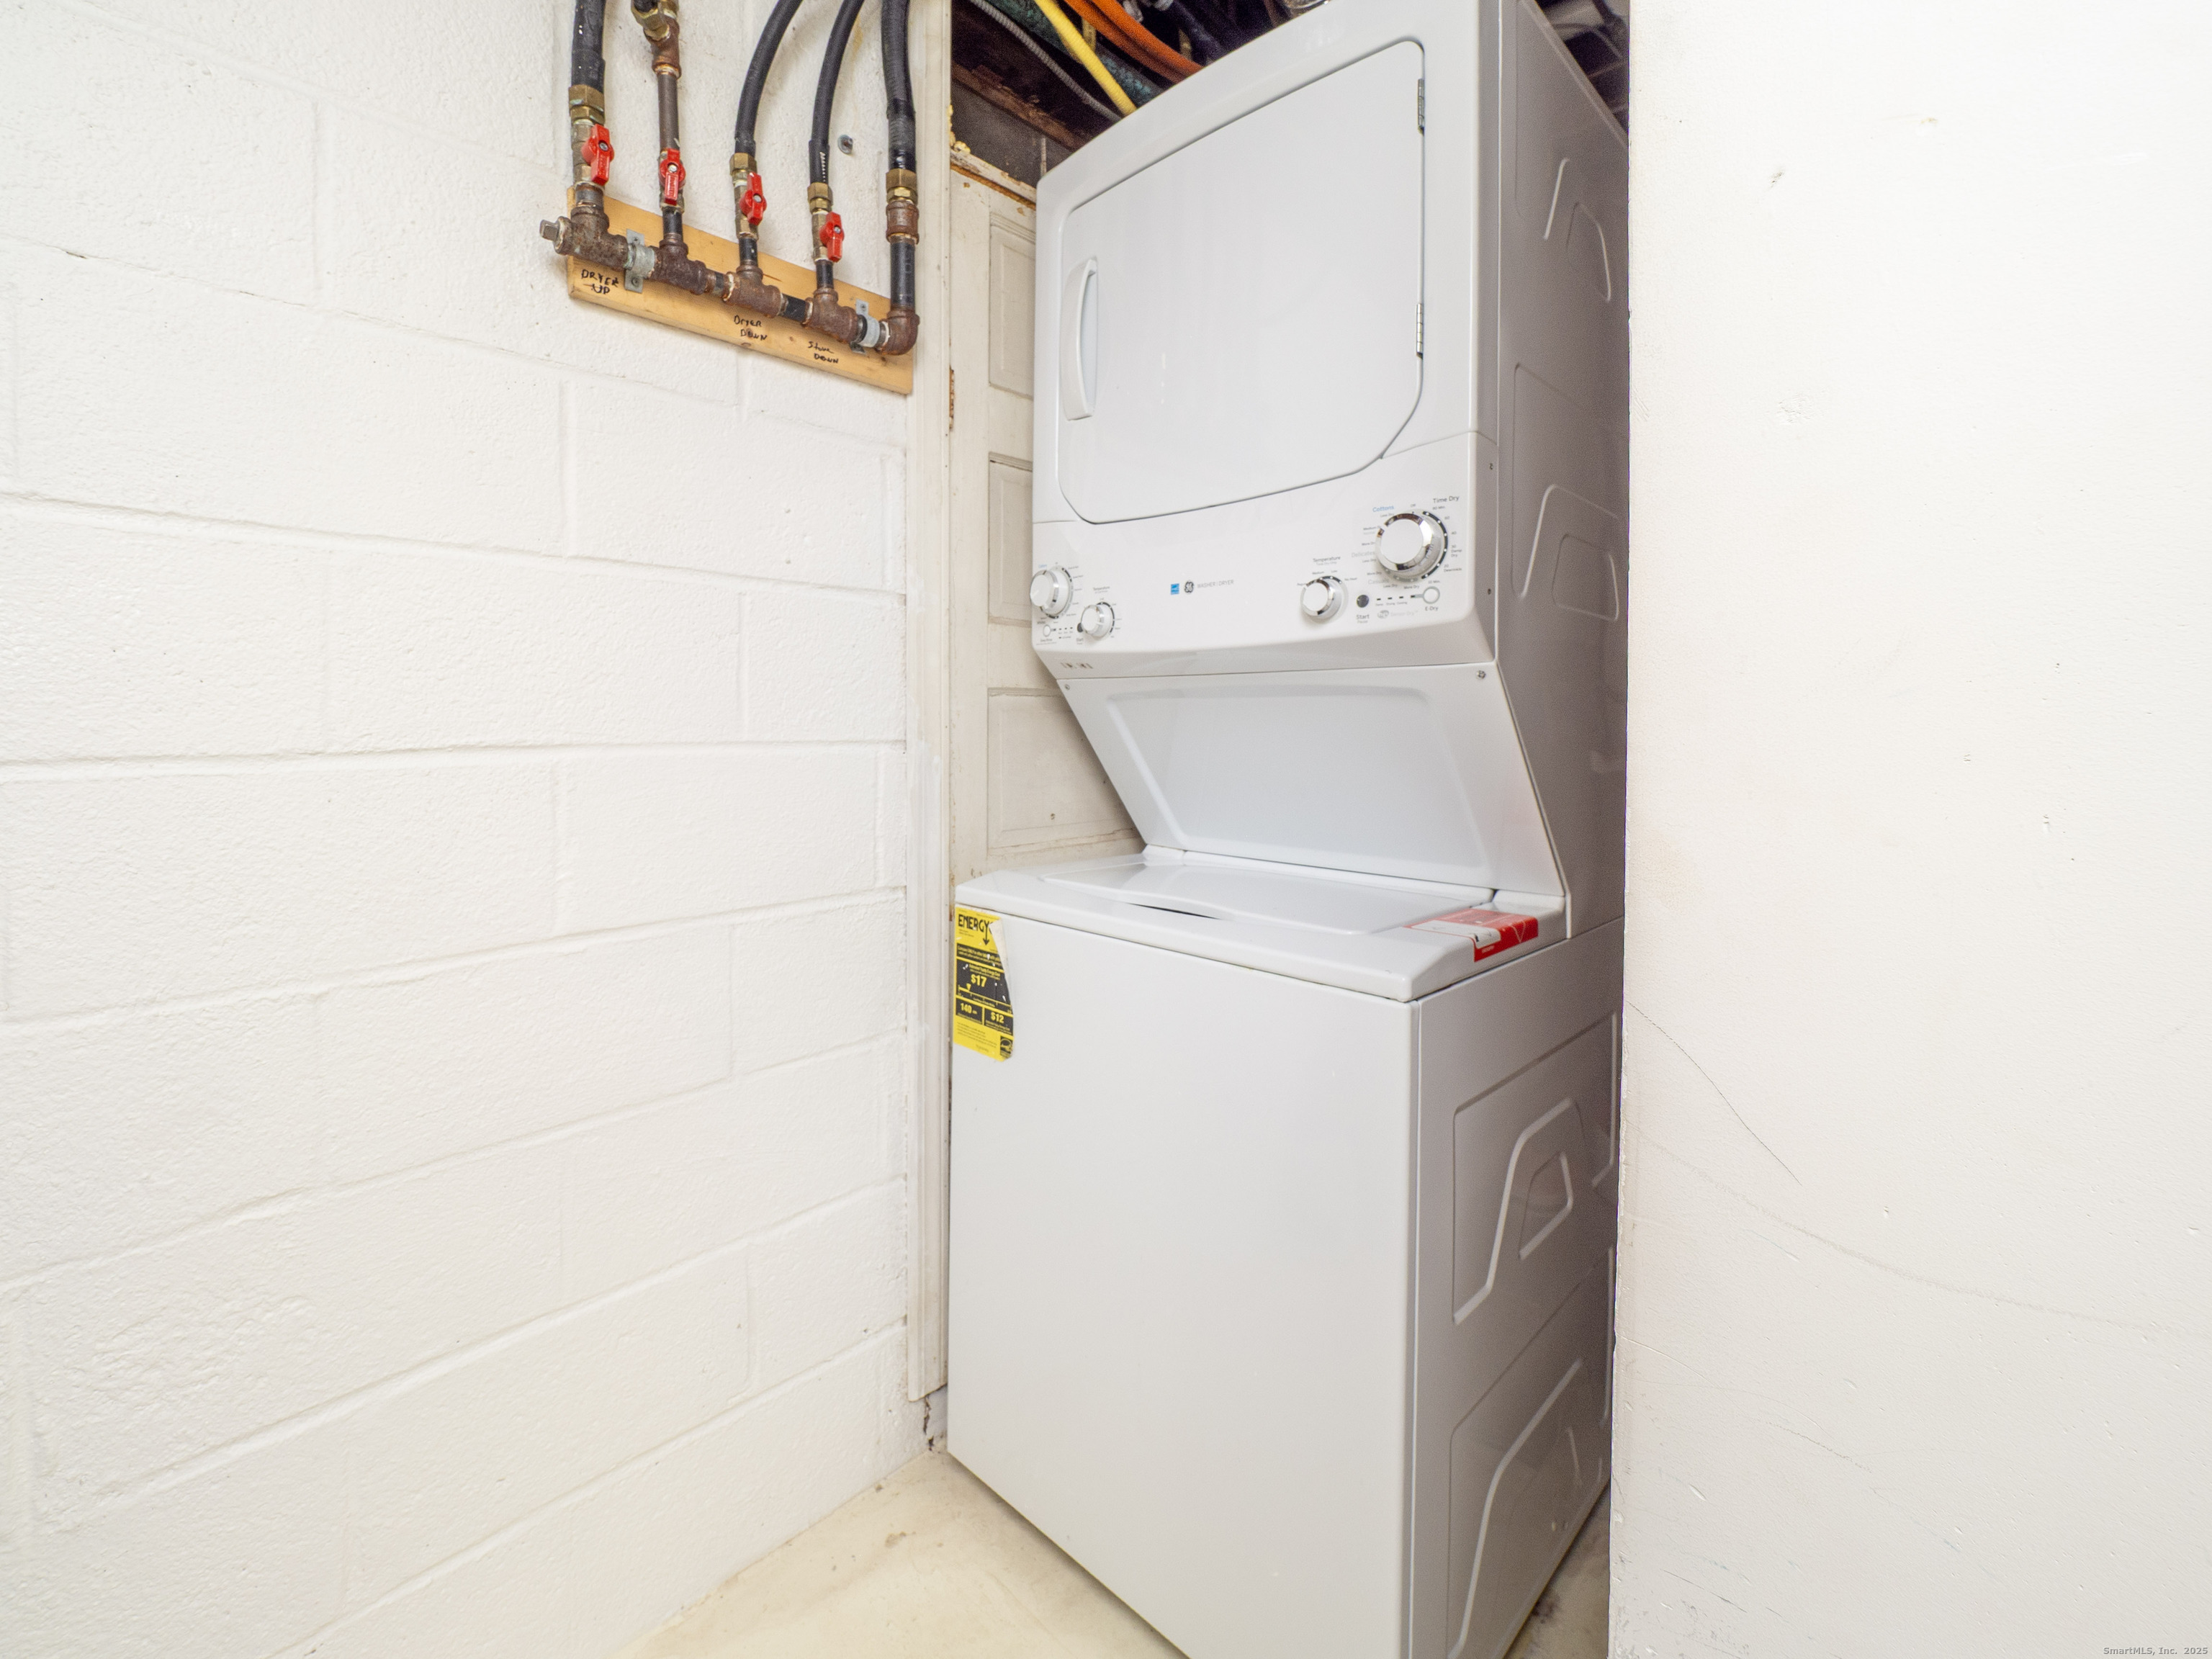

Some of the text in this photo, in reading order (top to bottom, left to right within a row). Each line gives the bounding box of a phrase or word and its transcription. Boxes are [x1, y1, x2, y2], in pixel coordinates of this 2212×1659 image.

[581, 269, 619, 287] DRYER
[591, 284, 611, 295] UP
[740, 329, 768, 341] DOWN
[814, 353, 839, 364] DOWN
[958, 913, 993, 935] ENERGY
[971, 974, 987, 987] $17
[990, 1011, 1004, 1023] $12
